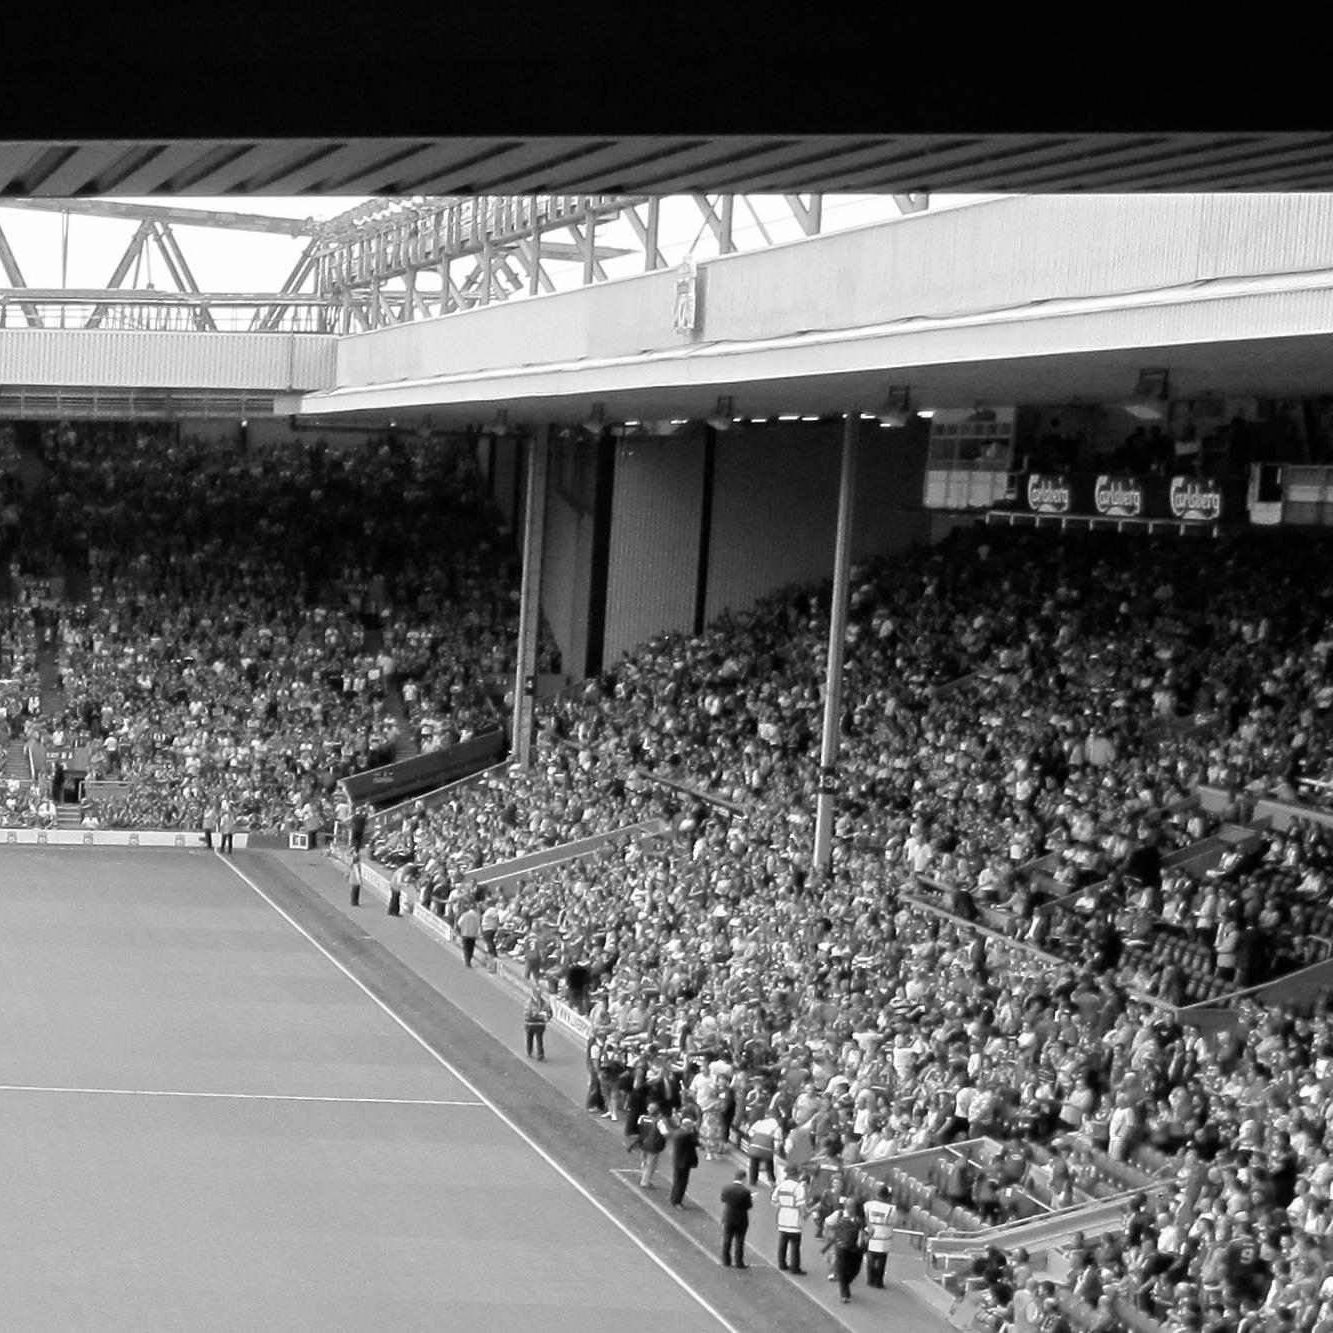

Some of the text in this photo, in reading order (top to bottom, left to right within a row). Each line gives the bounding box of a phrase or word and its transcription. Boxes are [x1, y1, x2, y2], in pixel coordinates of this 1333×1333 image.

[1027, 474, 1069, 513] Carlsberg
[1095, 475, 1140, 516] Carlsberg
[1170, 477, 1220, 520] Carlsberg
